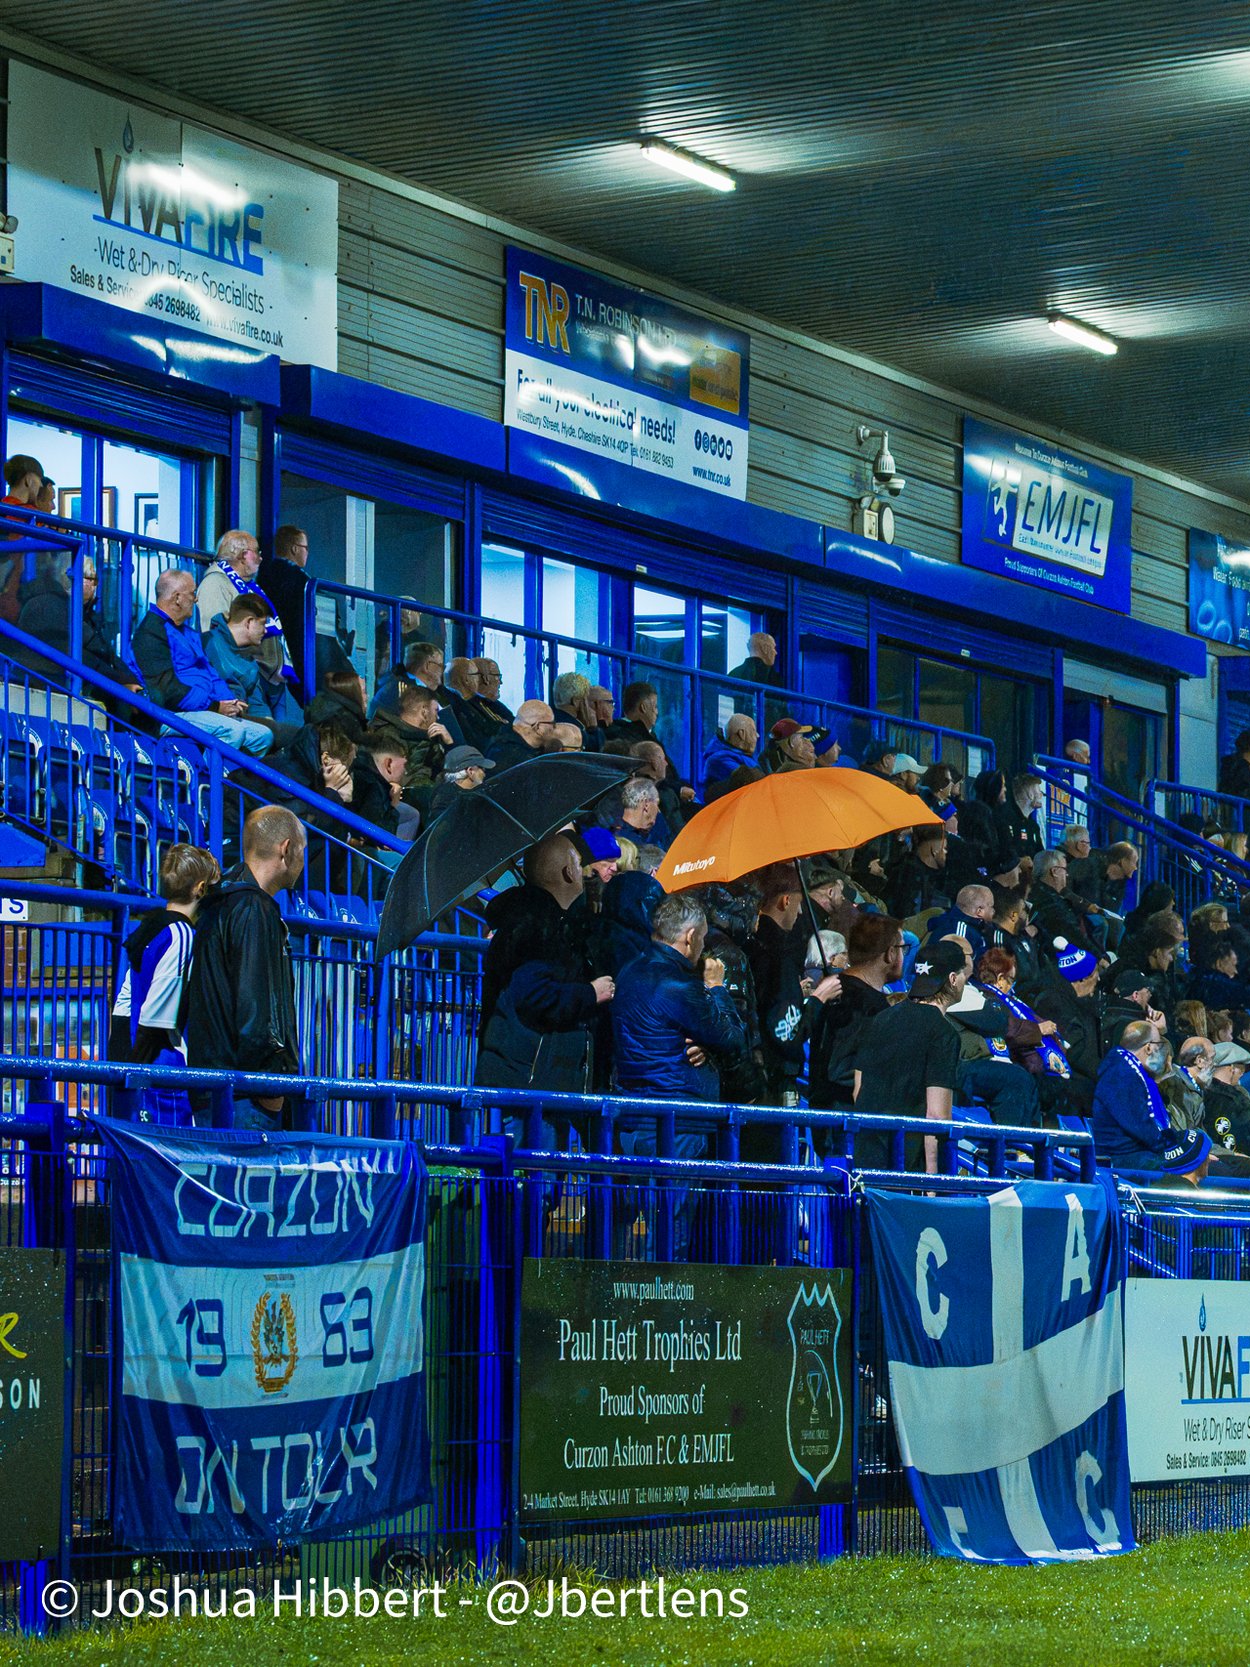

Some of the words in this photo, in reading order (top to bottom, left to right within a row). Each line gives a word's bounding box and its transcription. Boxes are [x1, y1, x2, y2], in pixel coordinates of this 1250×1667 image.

[69, 264, 95, 289] Sales
[97, 273, 104, 291] &
[97, 235, 125, 271] Wet
[201, 270, 265, 315] Specialists
[519, 270, 571, 354] TNR
[640, 413, 677, 445] needs!
[1021, 480, 1103, 555] EMJFL
[613, 1276, 694, 1304] www.paulhett.com
[558, 1319, 597, 1362] Paul
[602, 1320, 639, 1362] Hett
[642, 1319, 711, 1373] Trophies
[714, 1320, 742, 1361] Ltd
[600, 1385, 635, 1416] Proud
[638, 1385, 690, 1424] Sponsors
[692, 1384, 706, 1415] of
[1184, 1417, 1201, 1442] Wet
[1201, 1418, 1209, 1441] &
[1209, 1417, 1225, 1445] Dry
[1224, 1416, 1247, 1441] Riser
[563, 1437, 609, 1470] Curzon
[612, 1437, 653, 1467] Ashton
[656, 1435, 676, 1465] F.C
[678, 1437, 689, 1464] &
[692, 1433, 735, 1463] EMJFL
[1166, 1453, 1183, 1470] Sales
[1182, 1452, 1187, 1469] &
[1188, 1451, 1210, 1469] Service:
[534, 1493, 557, 1510] Market
[580, 1490, 598, 1511] Hyde
